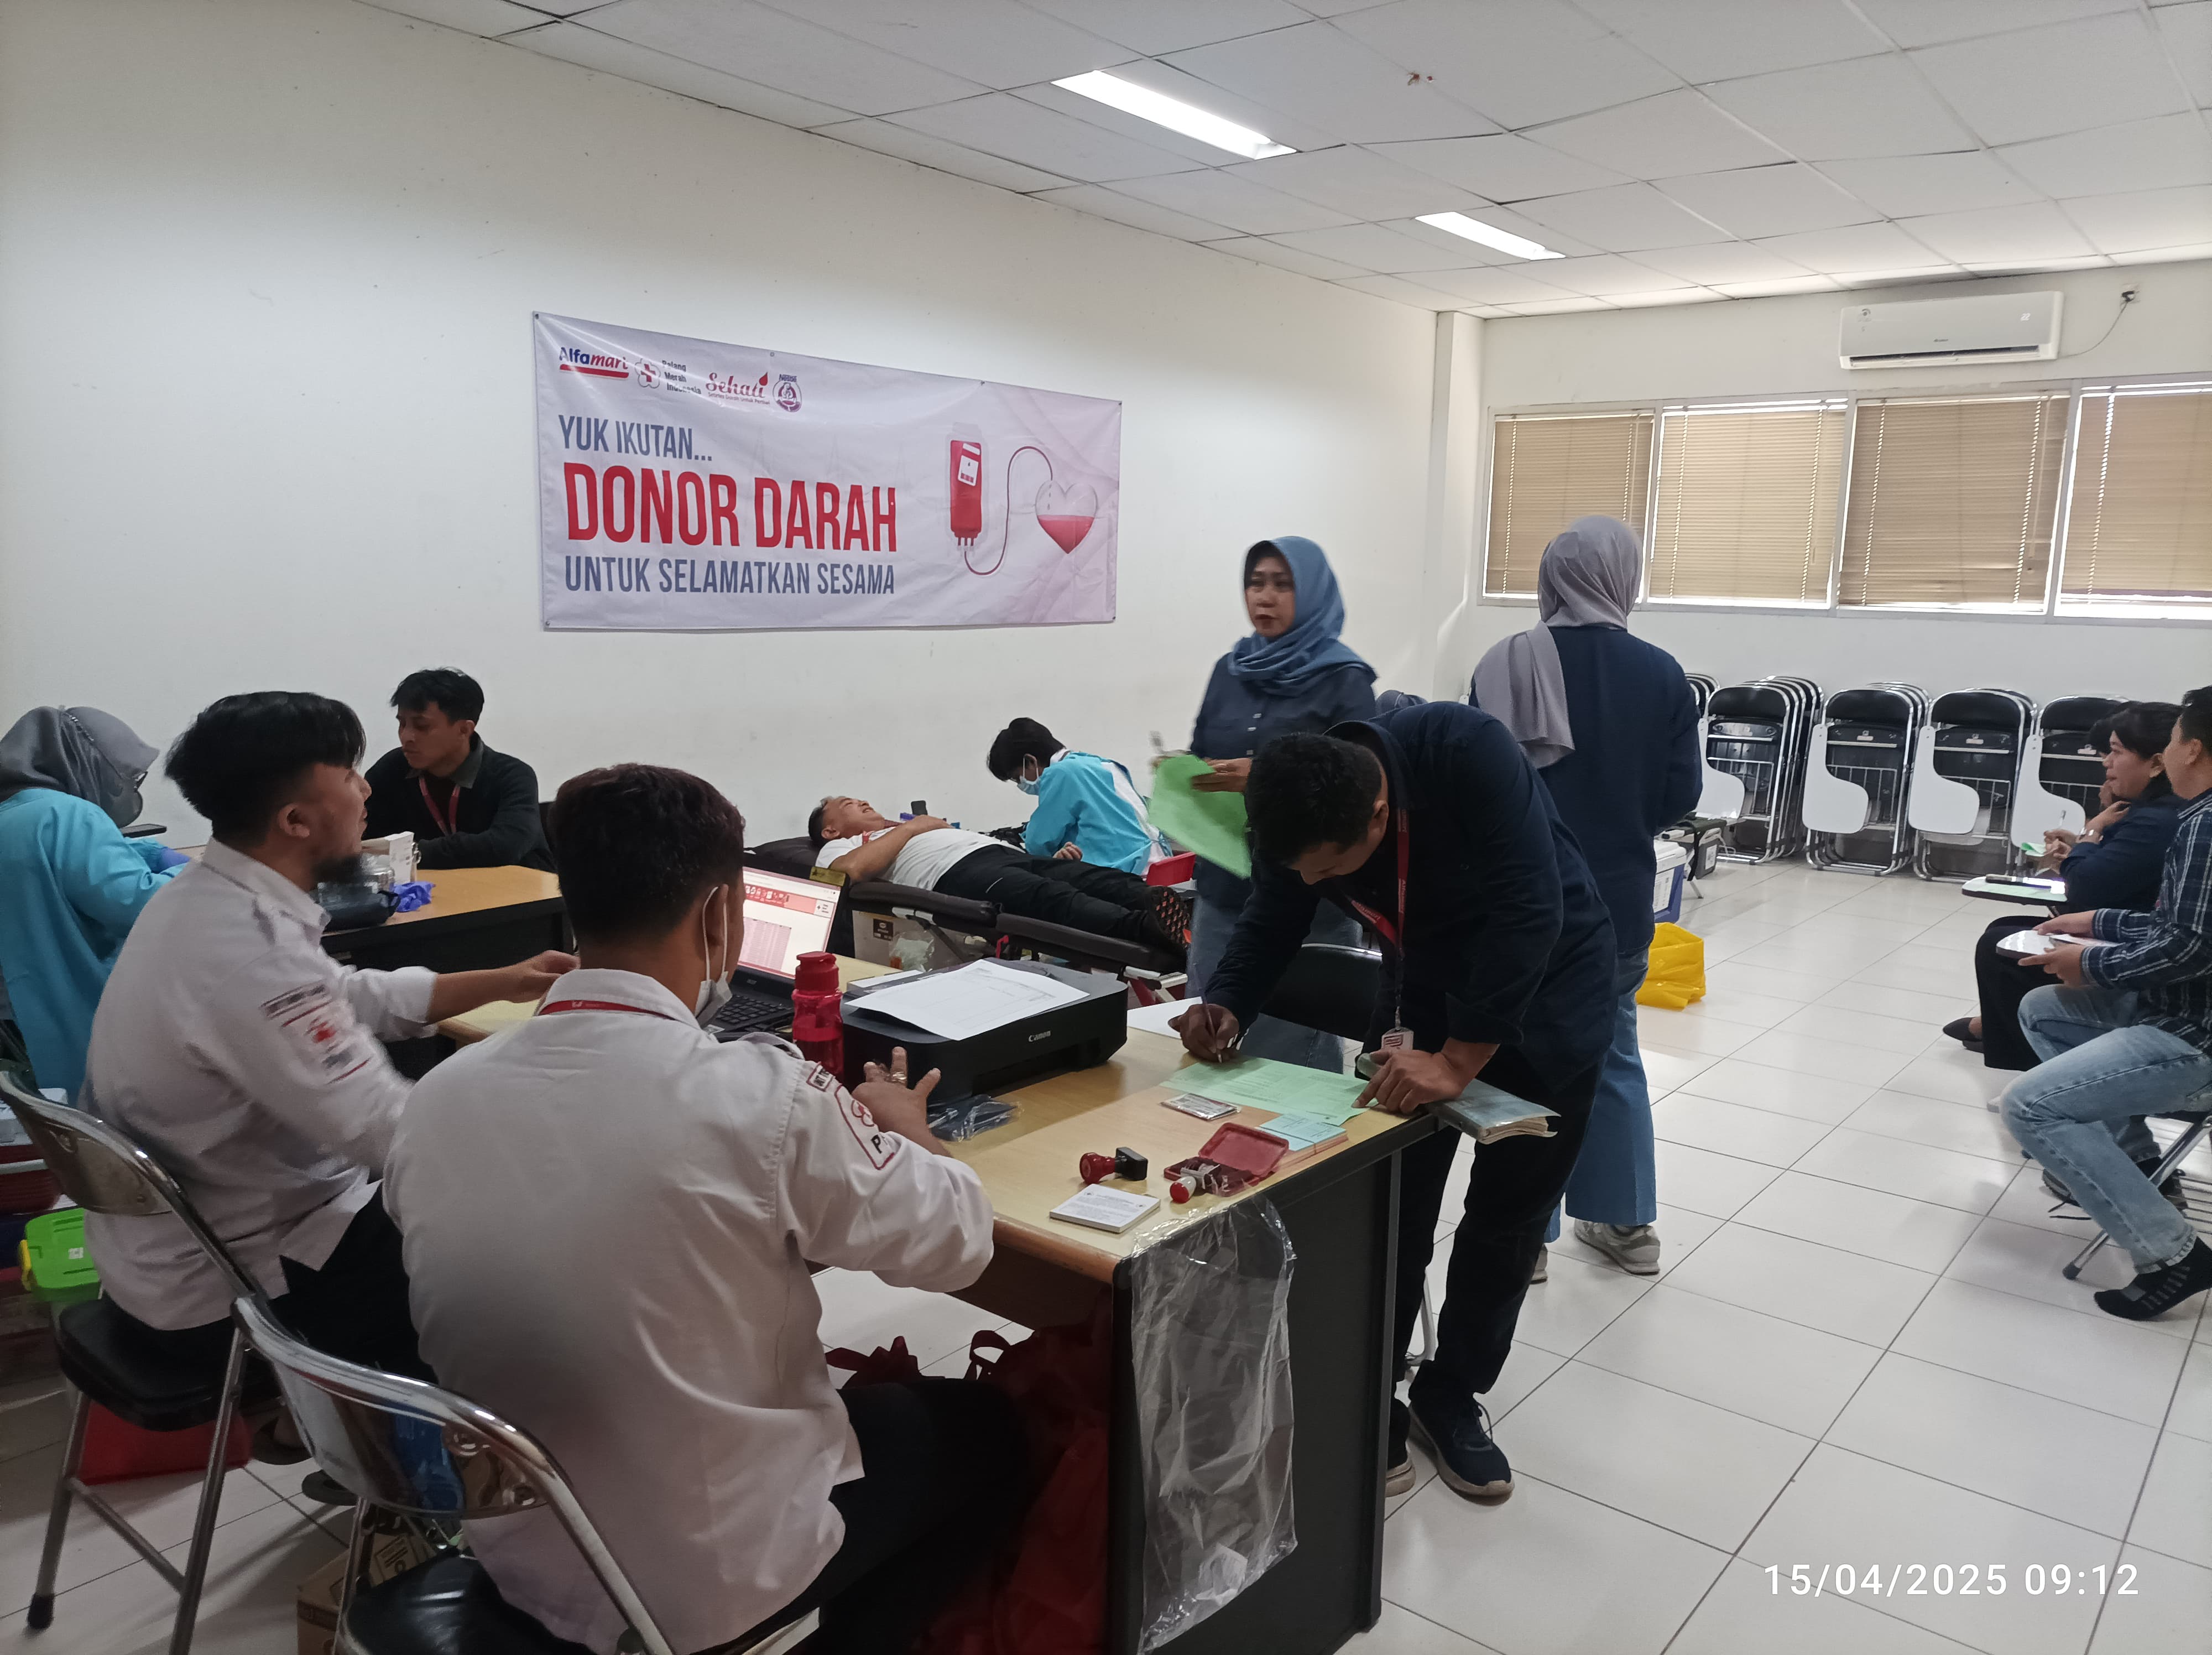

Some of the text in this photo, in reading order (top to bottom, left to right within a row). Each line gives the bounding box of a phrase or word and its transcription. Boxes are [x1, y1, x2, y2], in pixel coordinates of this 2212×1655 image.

[705, 371, 768, 398] Sehati
[558, 415, 712, 461] YUK IKUTAN...
[564, 462, 897, 552] DONOR DARAH
[565, 555, 895, 595] UNTUK SELAMATKAN SESAMA
[1028, 1030, 1051, 1042] Canon
